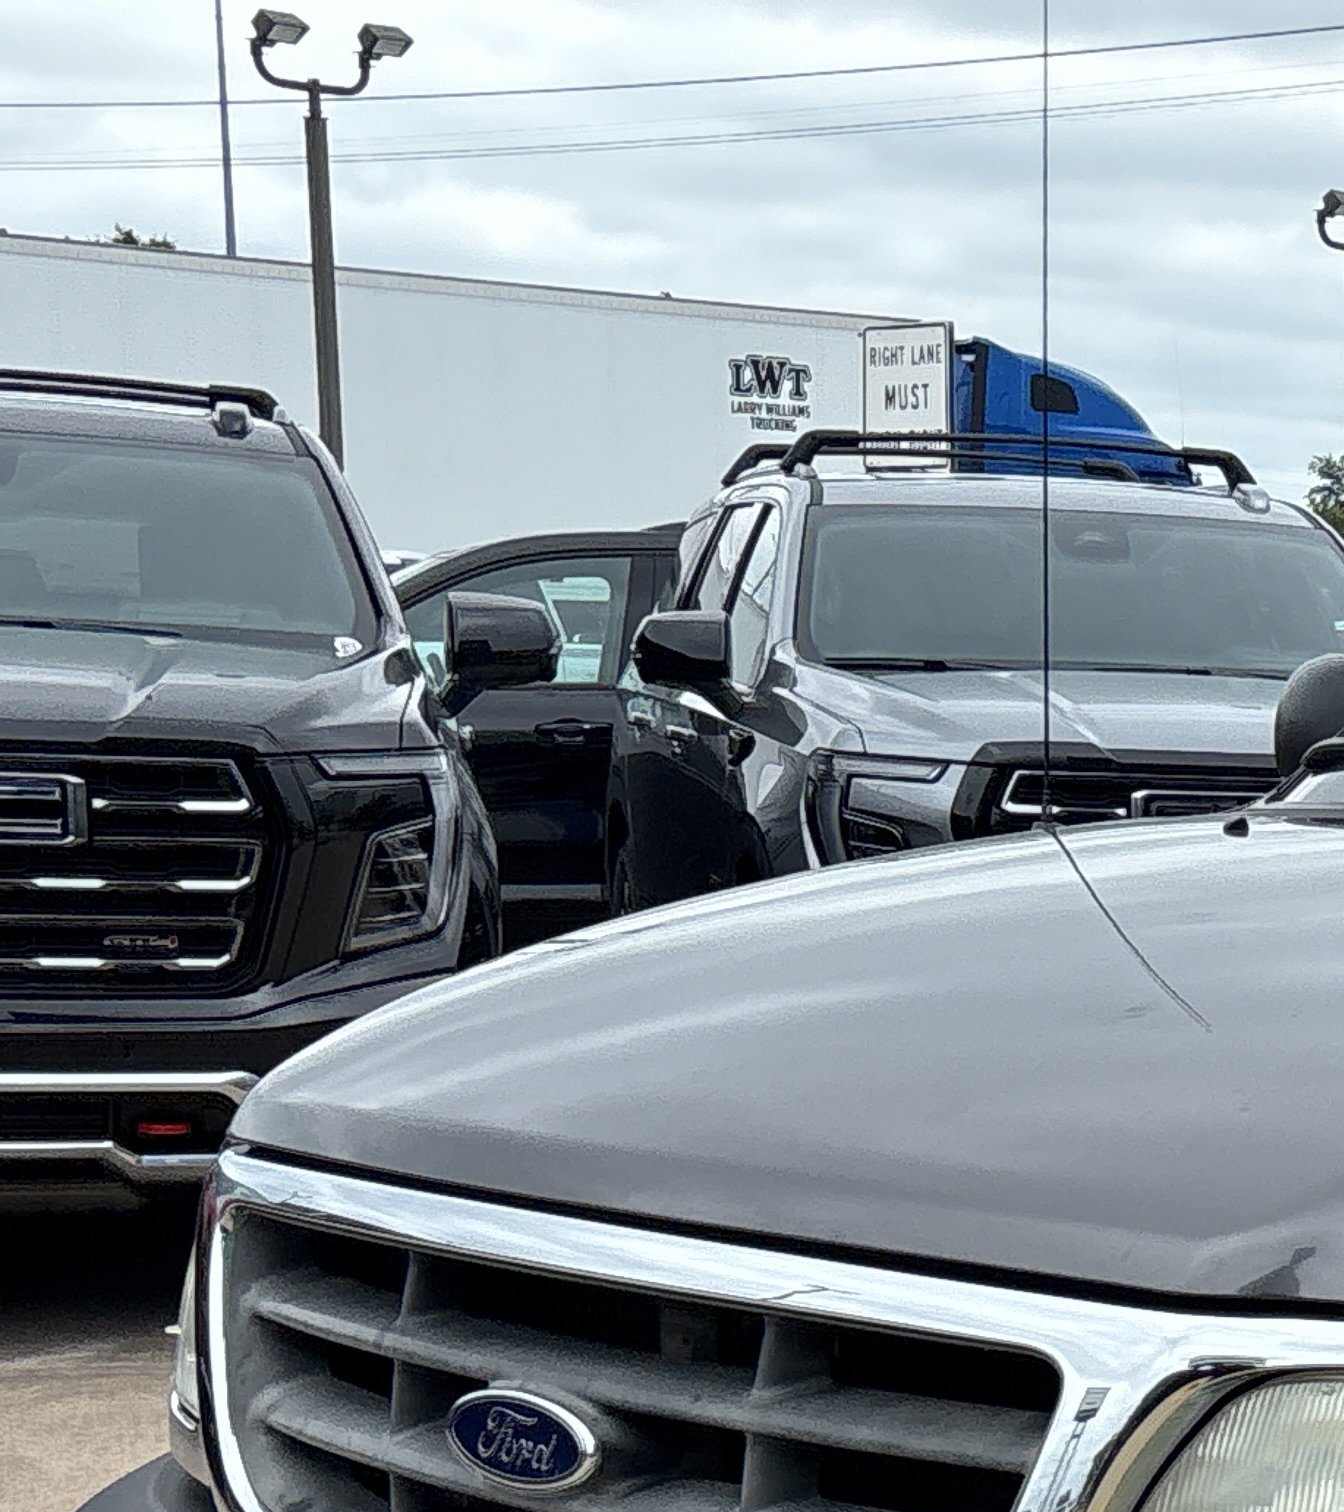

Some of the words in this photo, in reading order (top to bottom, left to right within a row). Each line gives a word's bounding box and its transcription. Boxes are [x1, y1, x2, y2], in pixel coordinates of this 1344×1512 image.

[870, 345, 905, 367] RIGHT
[911, 343, 943, 365] LANE
[729, 354, 812, 401] LWT
[731, 400, 763, 415] LARRY
[765, 402, 811, 419] WILLIAMS
[884, 383, 930, 411] MUST
[477, 1406, 558, 1471] Ford
